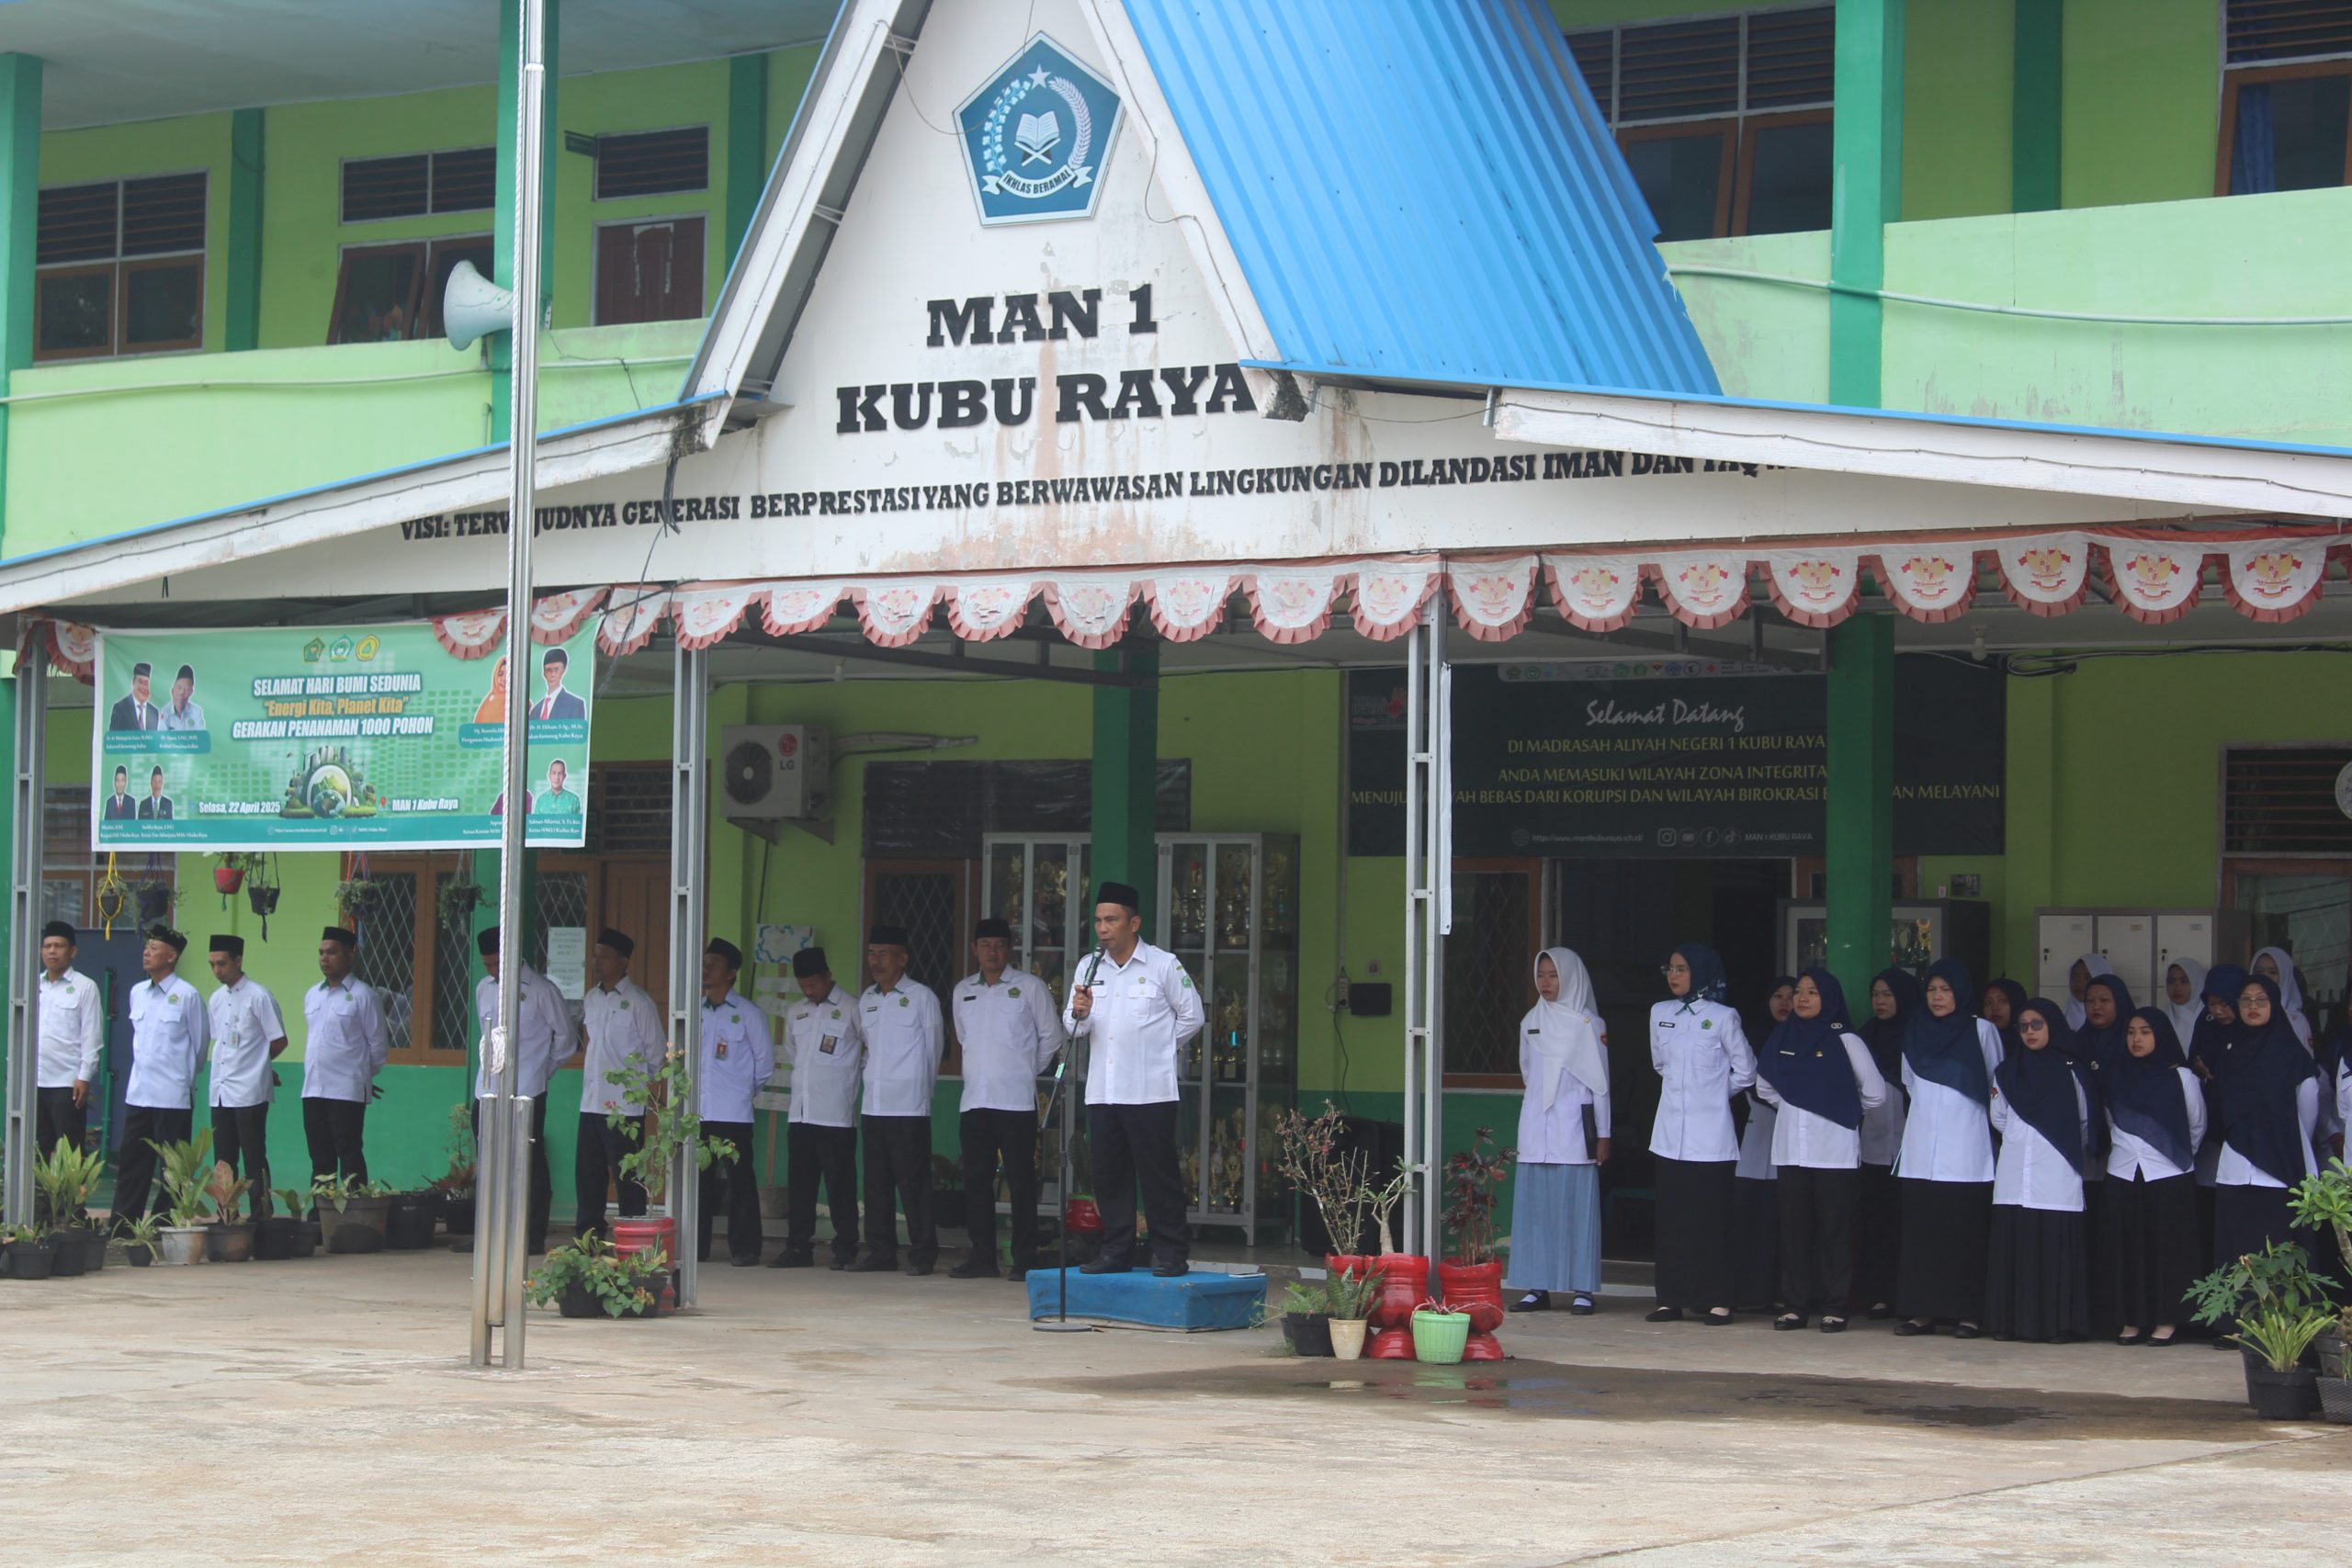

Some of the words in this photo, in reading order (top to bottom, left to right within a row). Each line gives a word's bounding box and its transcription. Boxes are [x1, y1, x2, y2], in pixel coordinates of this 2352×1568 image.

[1003, 174, 1032, 194] IKHLAS
[1033, 169, 1072, 194] BERAMAL
[927, 288, 1102, 347] MAN
[1129, 284, 1158, 334] 1
[836, 377, 1036, 434] KUBU
[1056, 363, 1258, 423] RAYA
[401, 514, 450, 540] VISI:
[454, 502, 617, 538] TERJUDNYA
[622, 496, 740, 525] GENERASI
[751, 487, 920, 518] BERPRESTASI
[922, 482, 989, 509] YANG
[997, 471, 1183, 505] BERWAWASAN
[1190, 462, 1372, 496] LINGKUNGAN
[1378, 454, 1536, 487] DILANDASI
[1543, 449, 1625, 479] IMAN
[1631, 452, 1693, 475] DAN
[254, 679, 304, 695] SELAMAT
[306, 677, 334, 694] HARI
[336, 676, 368, 693] BUMI
[369, 674, 421, 692] SEDUNIA
[309, 700, 335, 716] Kita,
[337, 698, 377, 714] Planet
[1587, 699, 1666, 726] Selamat
[1672, 699, 1745, 732] Datang
[232, 721, 287, 738] GERAKAN
[288, 719, 359, 737] PENANAMAN
[361, 718, 390, 735] 1000
[391, 716, 434, 734] POHON
[1508, 739, 1523, 753] DI
[1527, 739, 1611, 752] MADRASAH
[1613, 738, 1666, 751] ALIYAH
[1669, 737, 1724, 750] NEGERI
[1728, 737, 1735, 750] 1
[1739, 736, 1781, 750] KUBU
[1785, 735, 1825, 749] RAYA
[779, 760, 795, 771] LG
[1498, 769, 1541, 782] ANDA
[1544, 768, 1624, 782] MEMASUKI
[1628, 767, 1695, 781] WILAYAH
[1699, 766, 1744, 780] ZONA
[1747, 764, 1827, 779] INTEGRITA
[392, 799, 411, 811] MAN
[417, 798, 438, 810] Kubu
[438, 797, 458, 810] Raya
[1351, 791, 1408, 807] MENUJU
[1479, 790, 1522, 803] BEBAS
[1525, 790, 1559, 803] DARI
[1563, 789, 1626, 803] KORUPSI
[1630, 789, 1663, 803] DAN
[1667, 788, 1735, 802] WILAYAH
[1738, 786, 1818, 801] BIROKRASI
[1891, 785, 1915, 799] AN
[1918, 784, 2000, 799] MELAYANI
[198, 801, 227, 814] Selasa,
[228, 801, 239, 813] 22
[240, 801, 260, 814] April
[260, 801, 280, 813] 2025
